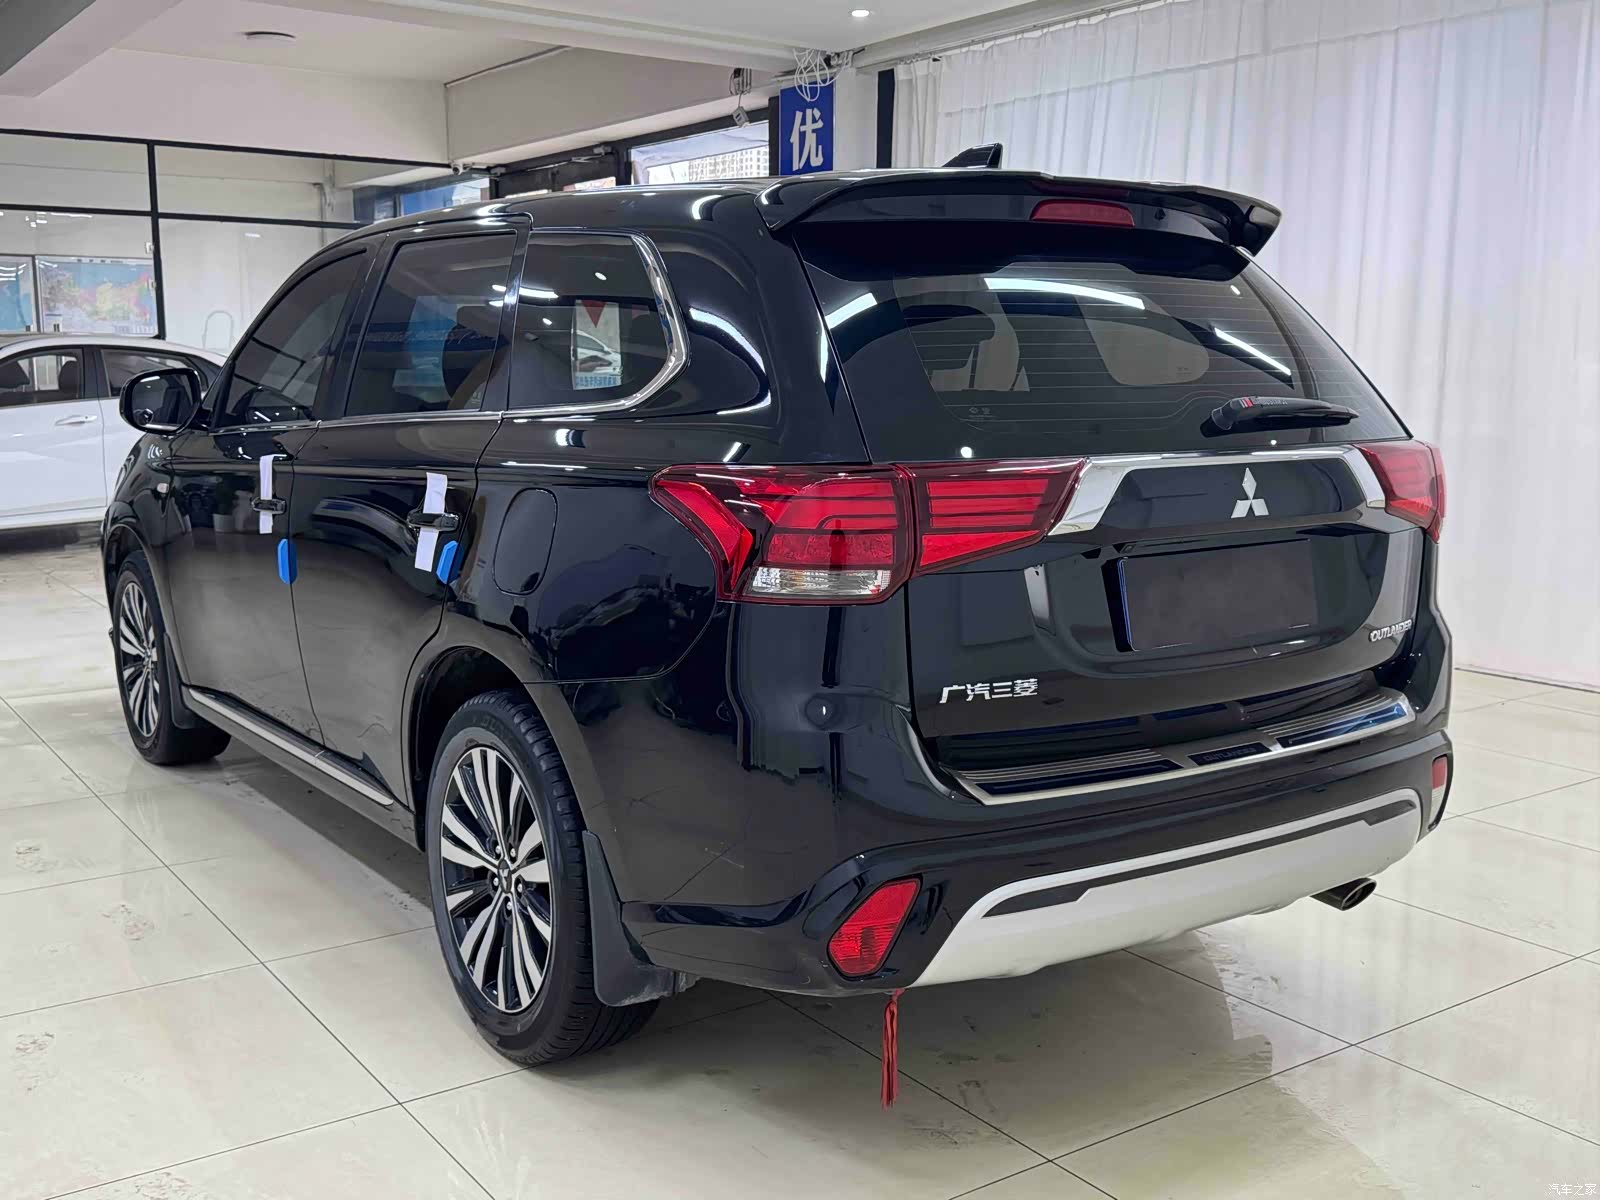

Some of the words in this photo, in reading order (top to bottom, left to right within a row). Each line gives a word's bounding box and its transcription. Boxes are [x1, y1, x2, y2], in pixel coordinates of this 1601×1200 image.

[789, 107, 824, 172] 优
[1369, 619, 1412, 642] OUTLANDER
[939, 678, 1038, 704] 广汽三菱
